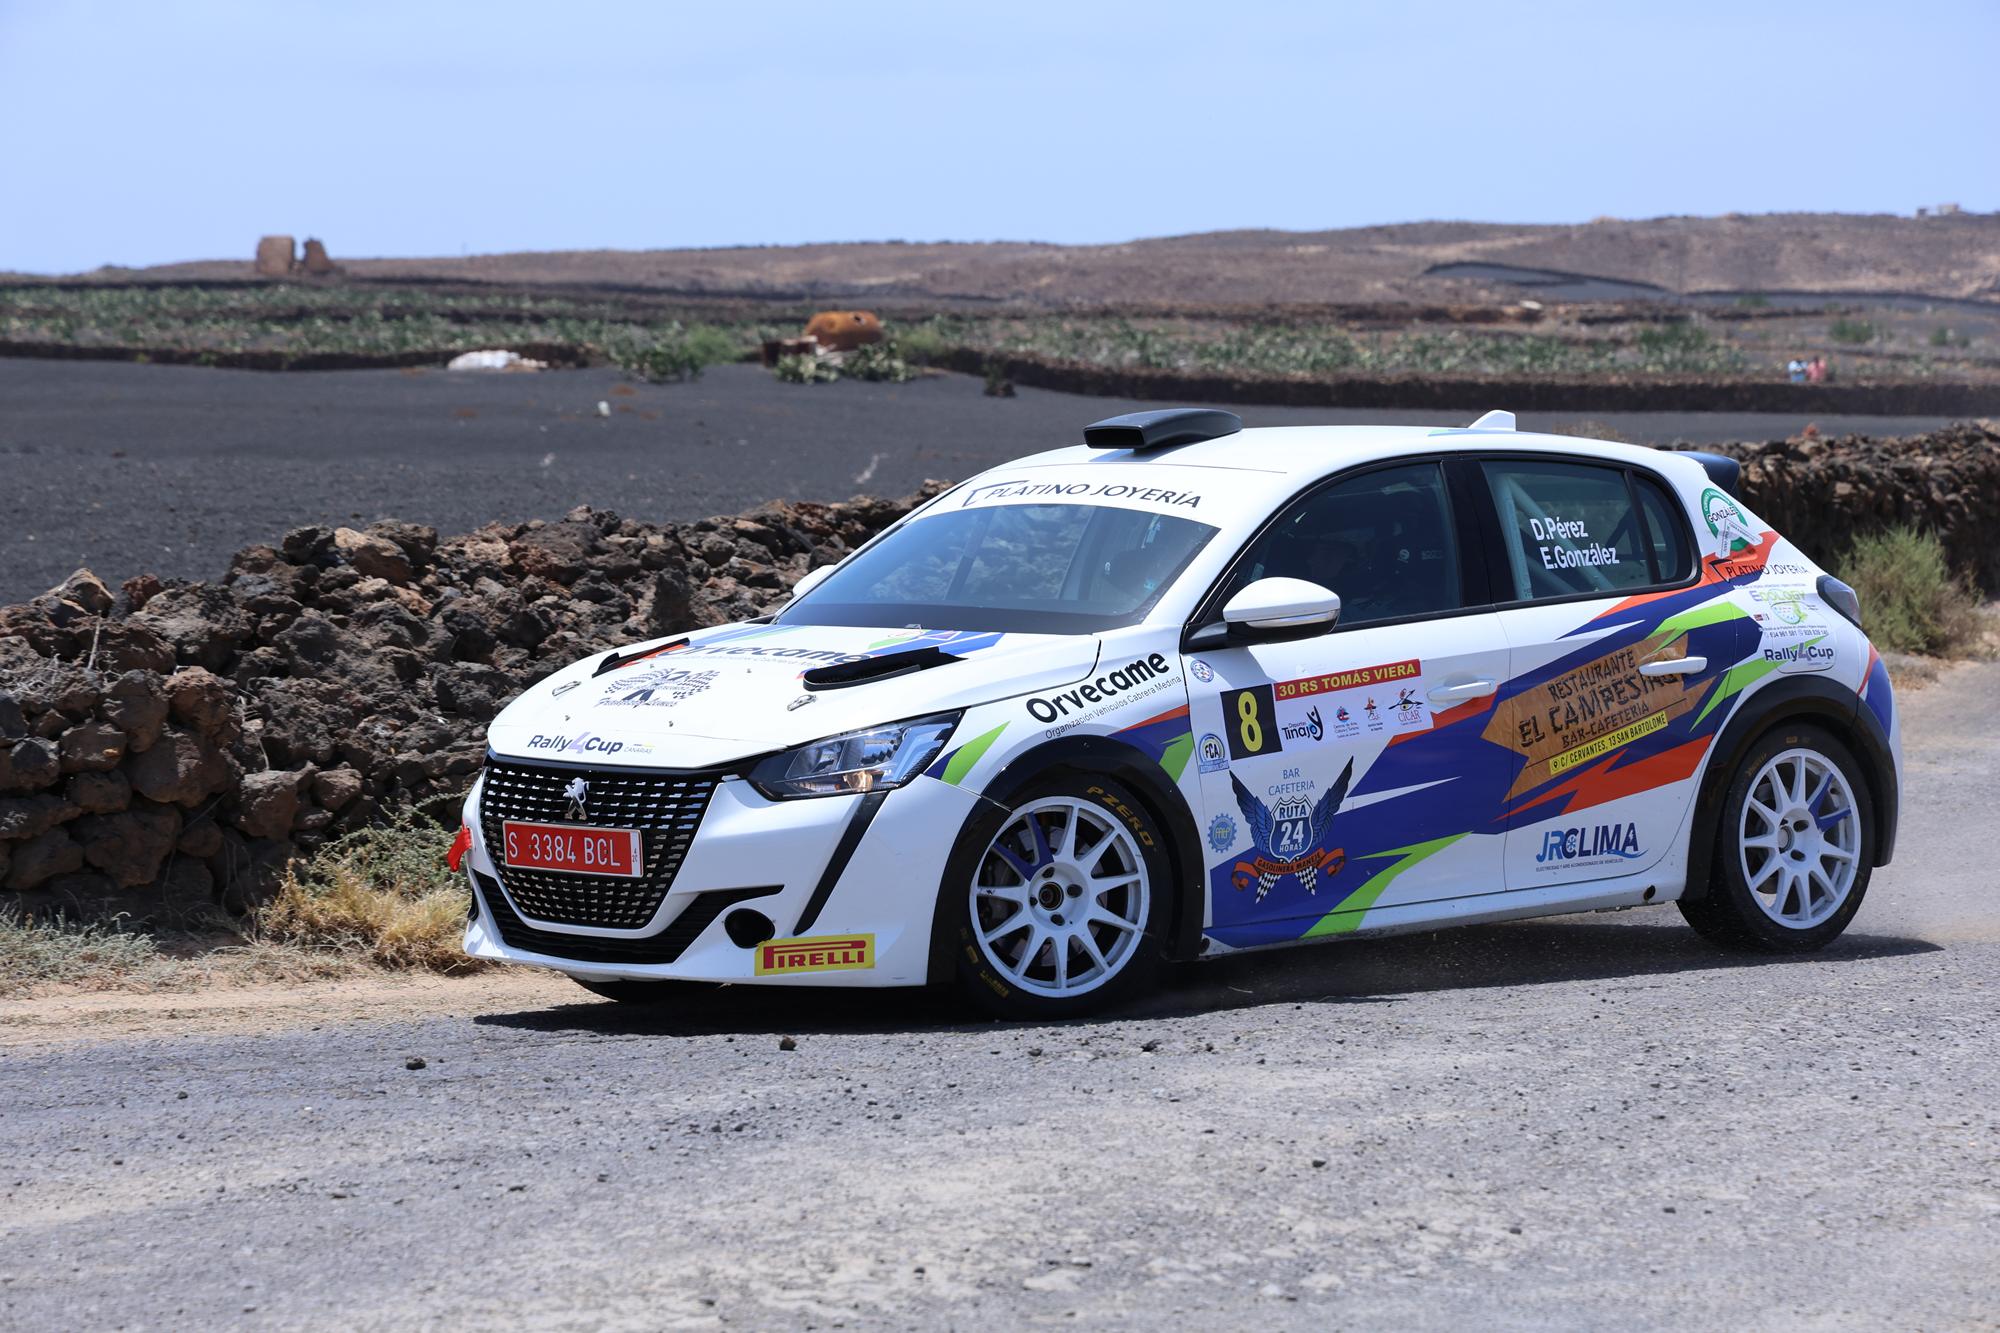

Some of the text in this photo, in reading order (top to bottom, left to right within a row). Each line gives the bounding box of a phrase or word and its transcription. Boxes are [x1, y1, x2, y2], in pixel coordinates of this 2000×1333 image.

[984, 484, 1202, 508] PLATINO JOYERÍA
[1529, 517, 1589, 541] D.Pérez
[1540, 543, 1620, 570] E.González
[1725, 564, 1770, 578] PLATINO
[656, 645, 871, 665] Orvecame
[1764, 642, 1834, 662] Rally4Cup
[1279, 663, 1416, 697] 30 RS TOMÁS VIERA
[1547, 649, 1636, 702] RESTAURANTE
[1026, 652, 1170, 724] Orvecame
[1045, 712, 1095, 739] Organización
[1127, 688, 1156, 703] Cabrera
[1154, 676, 1182, 692] Medina
[1398, 709, 1421, 722] CICAR
[1237, 691, 1263, 752] 8
[1518, 715, 1546, 748] EL
[527, 731, 624, 755] Rally4Cup
[1617, 731, 1629, 743] SAN
[1204, 743, 1221, 759] FCA
[1282, 767, 1300, 780] BAR
[1268, 780, 1316, 796] CAFETERIA
[1279, 804, 1308, 820] RUTA
[1280, 820, 1304, 846] 24
[1535, 822, 1640, 863] JRCLIMA
[508, 831, 621, 867] S 3384 BCL
[1279, 842, 1303, 853] HORAS
[763, 940, 867, 970] PIRELLI
